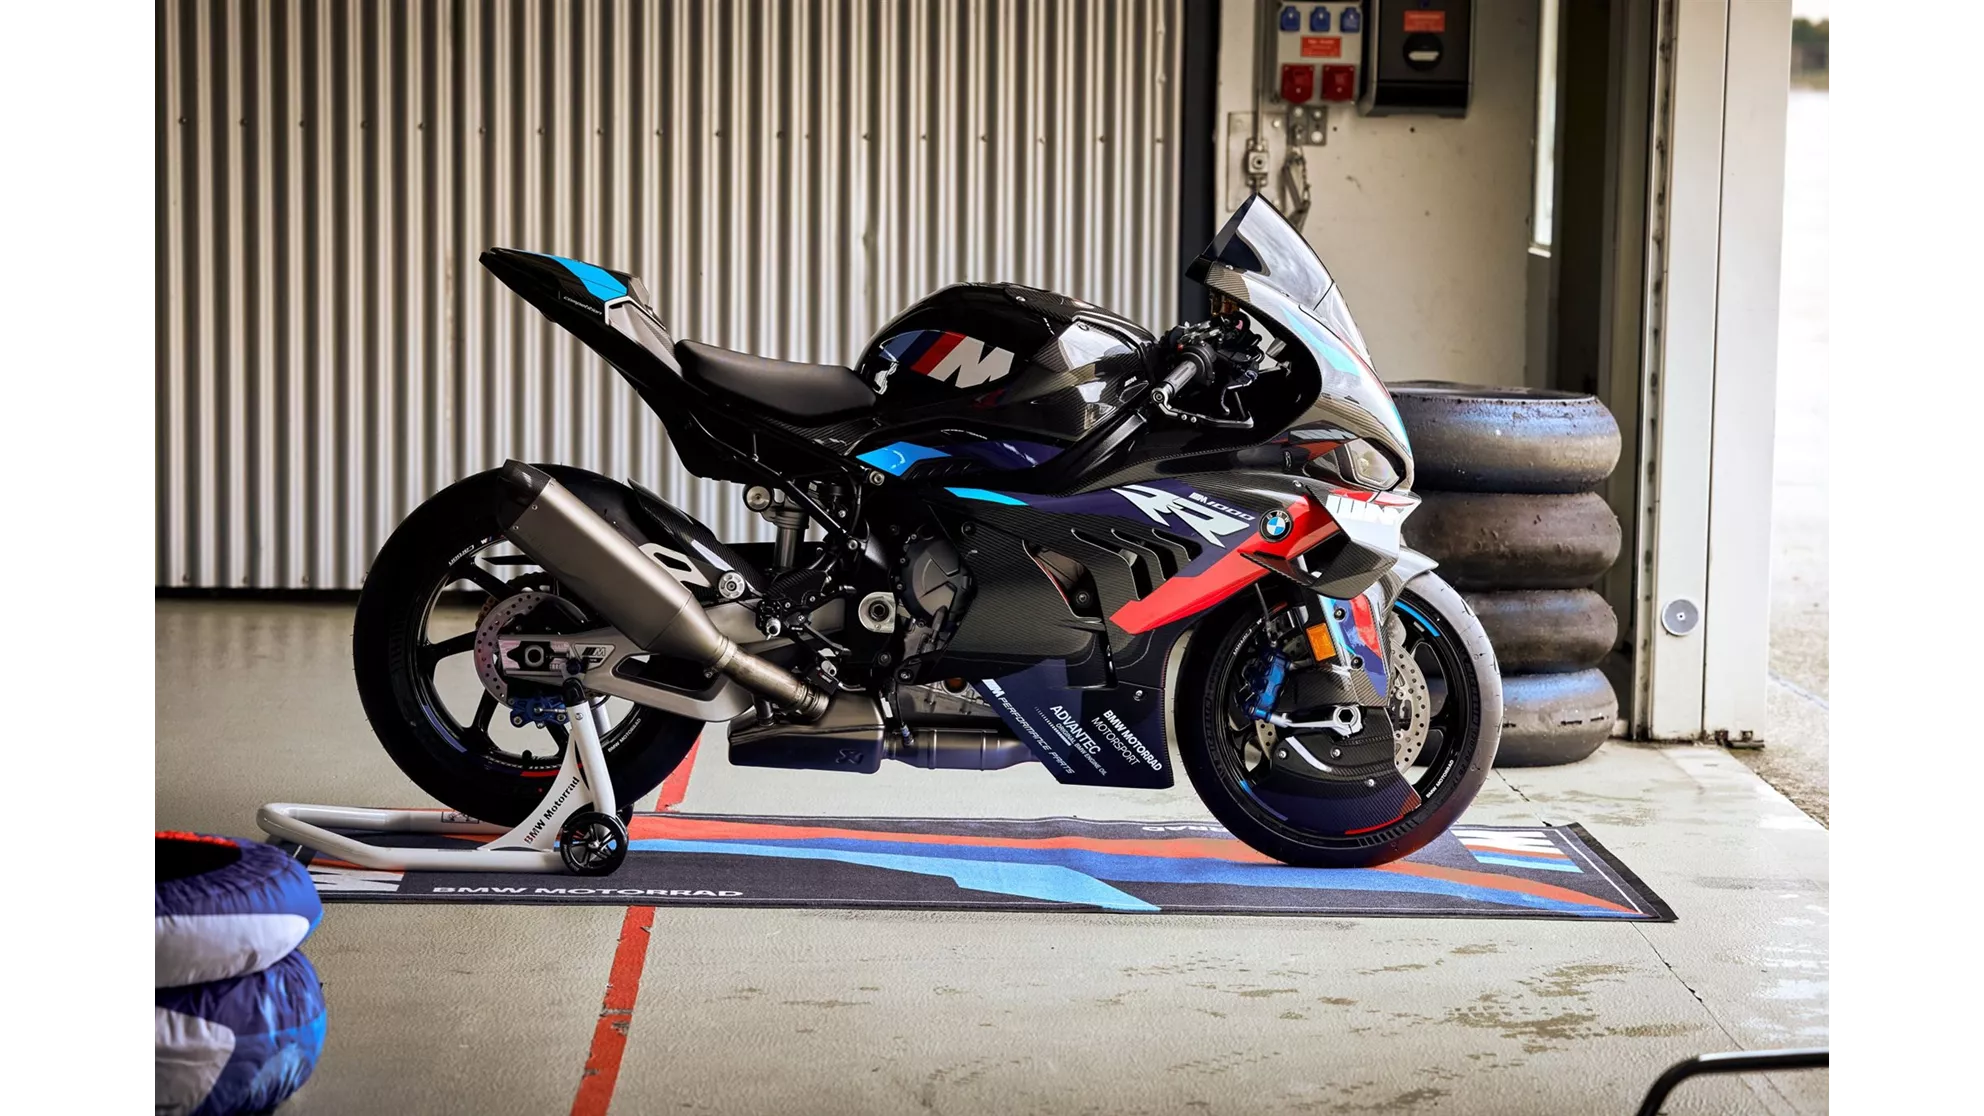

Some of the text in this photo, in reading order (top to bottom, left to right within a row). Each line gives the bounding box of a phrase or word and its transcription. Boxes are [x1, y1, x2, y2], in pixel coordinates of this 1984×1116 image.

[607, 718, 642, 753] BMW MOTORRAD
[998, 697, 1052, 751] PERFORMANCE
[1048, 751, 1075, 774] PARTS
[1050, 705, 1101, 754] ADVANTEC
[1056, 723, 1076, 744] ORIGINAL
[1074, 742, 1087, 754] BMW
[1084, 753, 1101, 769] ENGINE
[1091, 717, 1141, 765] MOTORSPORT
[1103, 709, 1163, 771] BMW MOTORRAD
[1425, 759, 1454, 798] BMW MOTORRAD
[524, 819, 546, 844] BMW
[543, 776, 580, 820] Motorrad
[432, 886, 744, 897] BMW MOTORRAD
